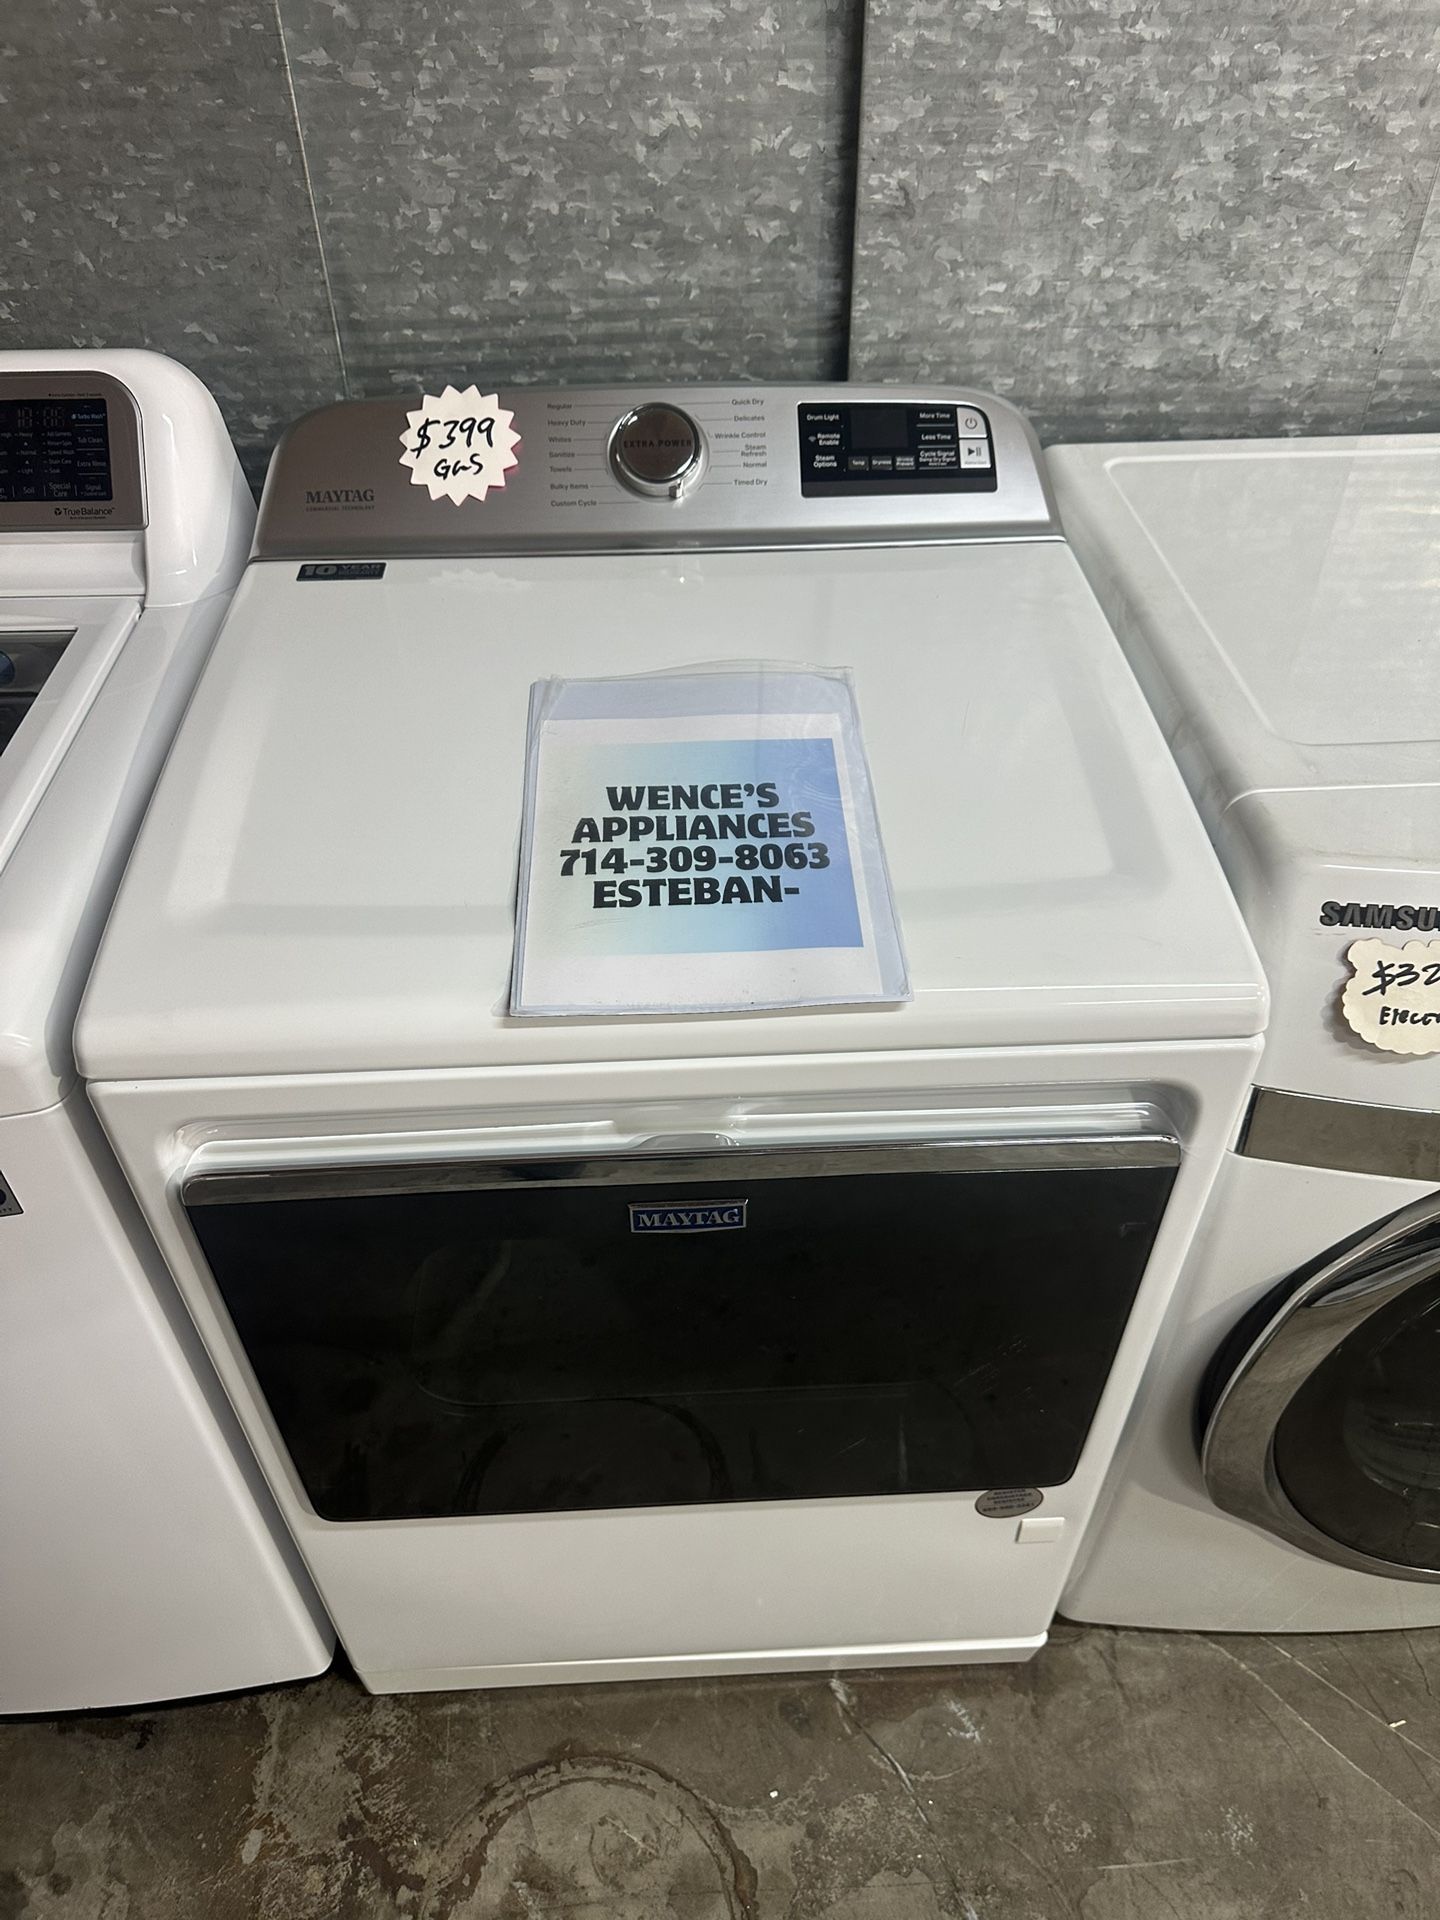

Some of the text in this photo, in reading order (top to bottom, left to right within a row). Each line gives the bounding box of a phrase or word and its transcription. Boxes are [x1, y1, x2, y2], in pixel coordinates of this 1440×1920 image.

[751, 398, 764, 406] Dry
[410, 417, 496, 459] $399
[624, 439, 692, 448] EXTRA POWER
[550, 483, 568, 491] Bulky
[755, 478, 768, 486] Dry
[305, 488, 375, 504] MAYTAG
[304, 565, 337, 576] 10
[606, 783, 780, 811] WENCE'S
[571, 812, 816, 843] APPLIANCES
[560, 842, 831, 877] 714-309-8063
[592, 875, 800, 909] ESTEBAN-
[1319, 900, 1440, 932] SAMSU
[638, 1208, 740, 1227] MAYTAG
